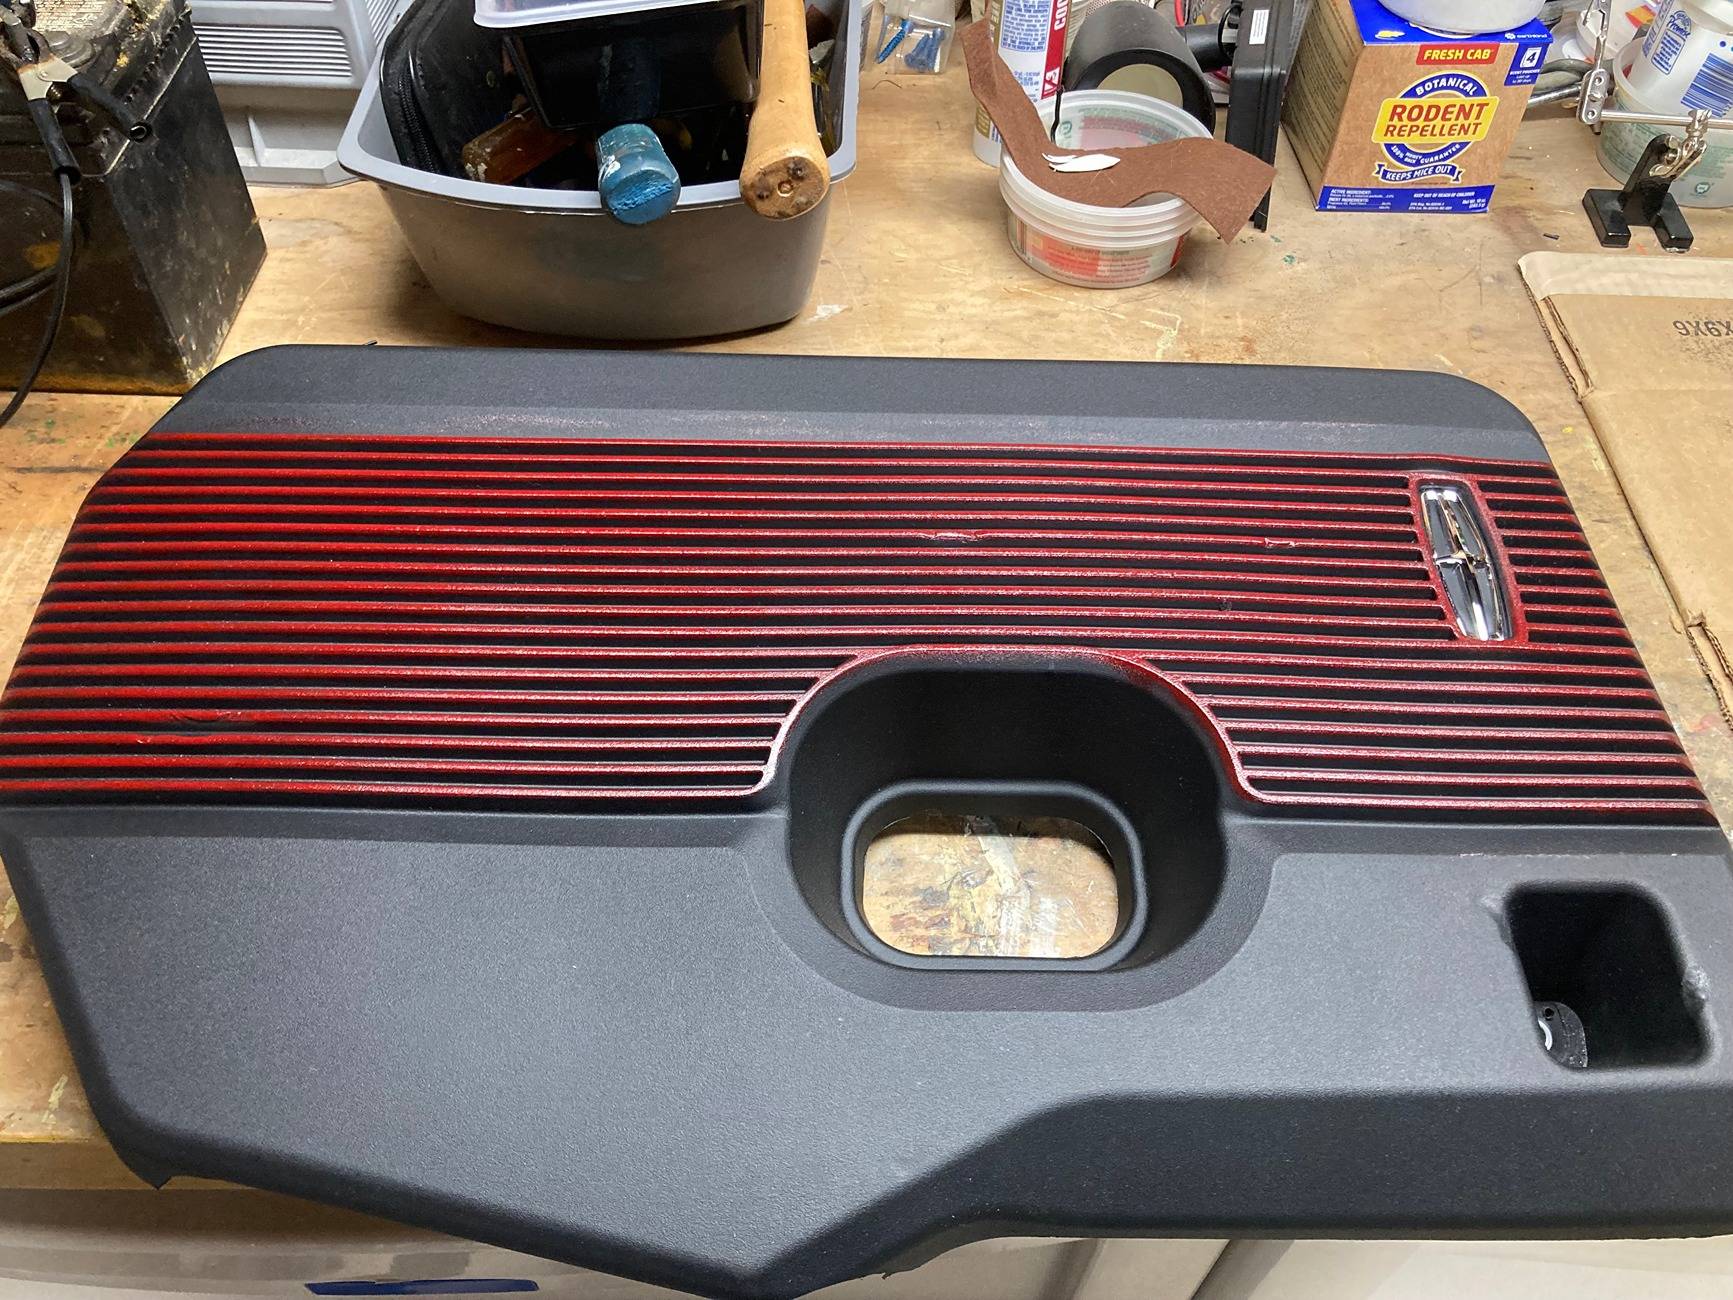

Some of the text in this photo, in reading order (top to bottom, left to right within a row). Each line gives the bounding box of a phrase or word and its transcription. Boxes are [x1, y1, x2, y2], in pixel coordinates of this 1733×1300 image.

[1423, 49, 1491, 61] FRESH CAB
[1526, 51, 1538, 63] 4
[1415, 77, 1478, 96] BOTANICAL
[1388, 103, 1490, 122] RODENT
[1384, 122, 1482, 137] REPELLENT
[1420, 143, 1461, 164] GUARANTEE
[1386, 165, 1453, 181] KEEPS MICE OUT
